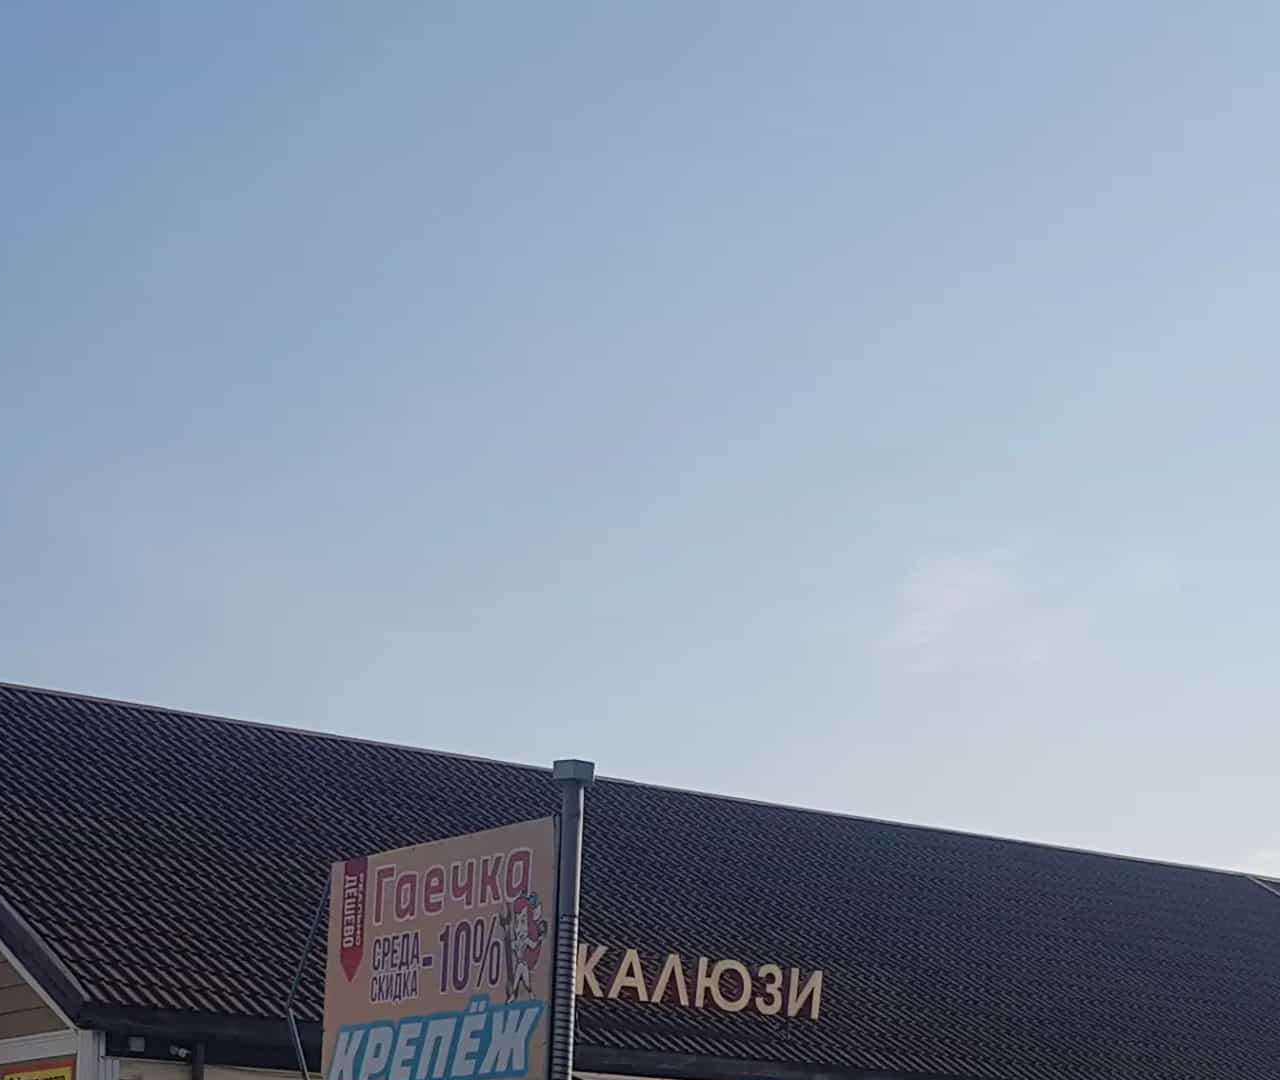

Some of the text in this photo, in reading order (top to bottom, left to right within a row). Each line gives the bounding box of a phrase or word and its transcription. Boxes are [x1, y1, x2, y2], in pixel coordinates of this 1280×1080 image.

[342, 874, 357, 949] ДЕШЕВО
[374, 847, 534, 926] Гаечка
[372, 929, 421, 972] СРЕДА
[370, 968, 419, 1003] СКИДКА
